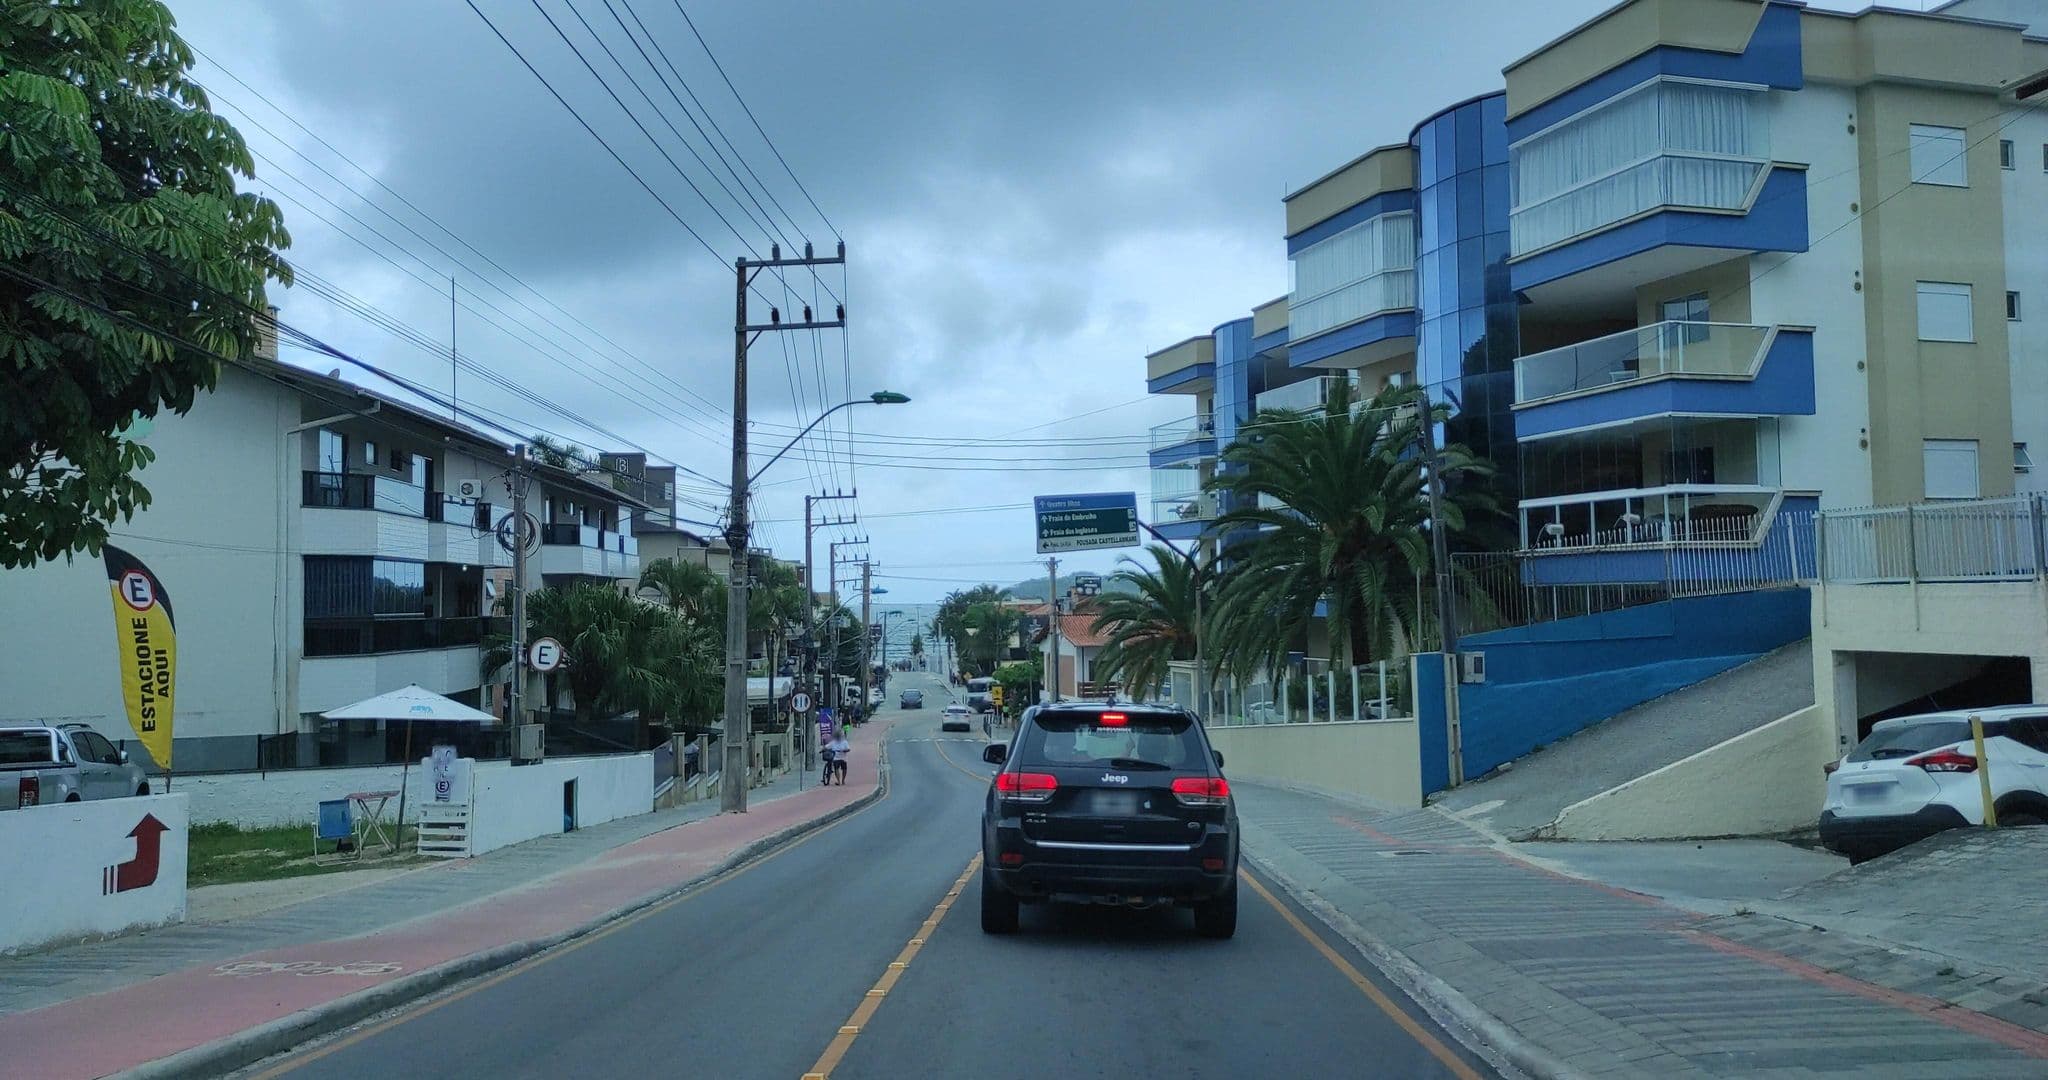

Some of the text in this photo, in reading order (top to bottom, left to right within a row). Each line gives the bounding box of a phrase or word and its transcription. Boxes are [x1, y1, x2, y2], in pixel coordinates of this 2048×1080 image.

[1076, 538, 1098, 546] POUSADA
[129, 578, 148, 602] E
[538, 646, 552, 664] E
[132, 617, 155, 733] ESTACIONE
[155, 648, 169, 698] AQUI
[1101, 773, 1128, 784] Jeep
